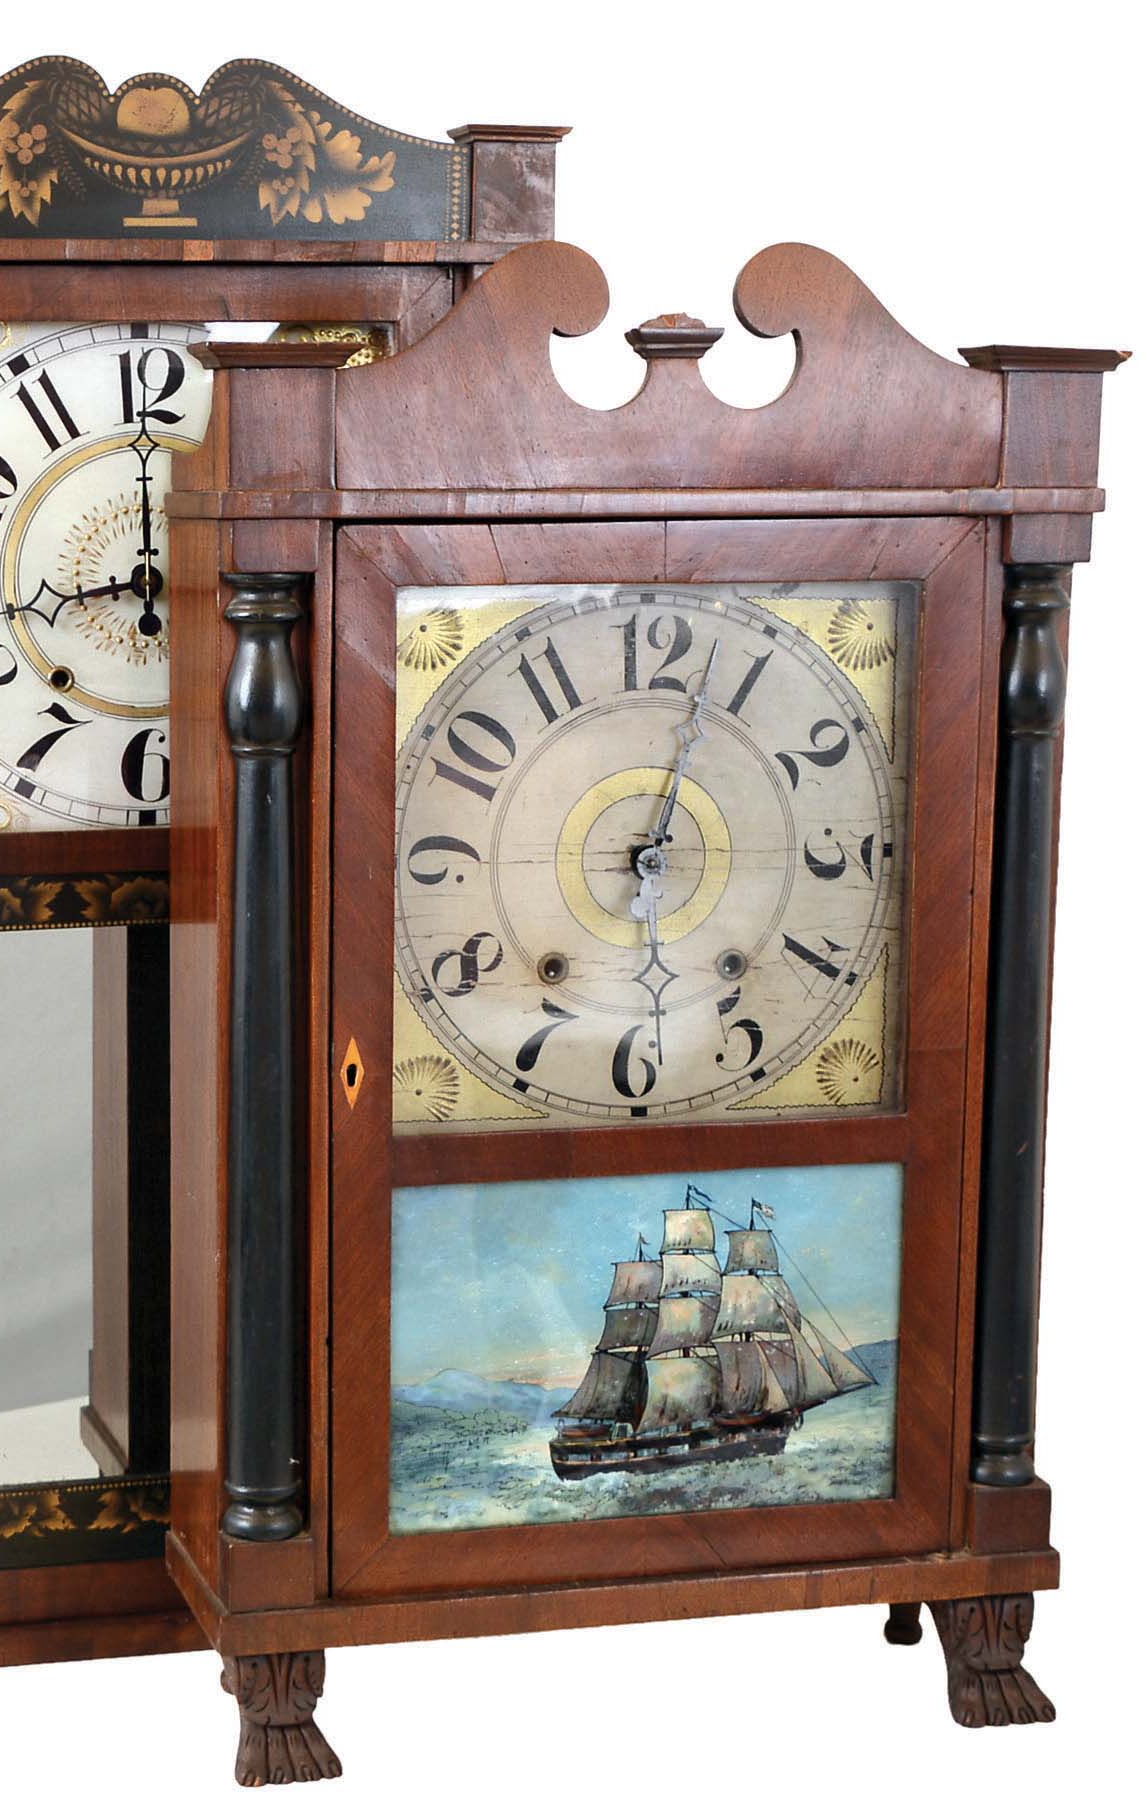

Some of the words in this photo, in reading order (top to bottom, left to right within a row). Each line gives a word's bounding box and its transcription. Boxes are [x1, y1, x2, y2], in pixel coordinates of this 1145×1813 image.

[11, 368, 89, 458] 11
[110, 347, 185, 425] 12
[507, 636, 596, 733] 11
[610, 612, 702, 694] 12
[716, 648, 774, 727] 1
[17, 702, 93, 772] 7
[121, 728, 170, 803] 6
[429, 710, 517, 805] 10
[774, 717, 850, 791] 2
[408, 835, 482, 885] 9
[804, 828, 874, 882] 3
[431, 931, 504, 997] 8
[780, 932, 851, 1002] 4
[515, 997, 580, 1072] 7
[611, 1024, 656, 1098] 6
[715, 985, 763, 1072] 5
